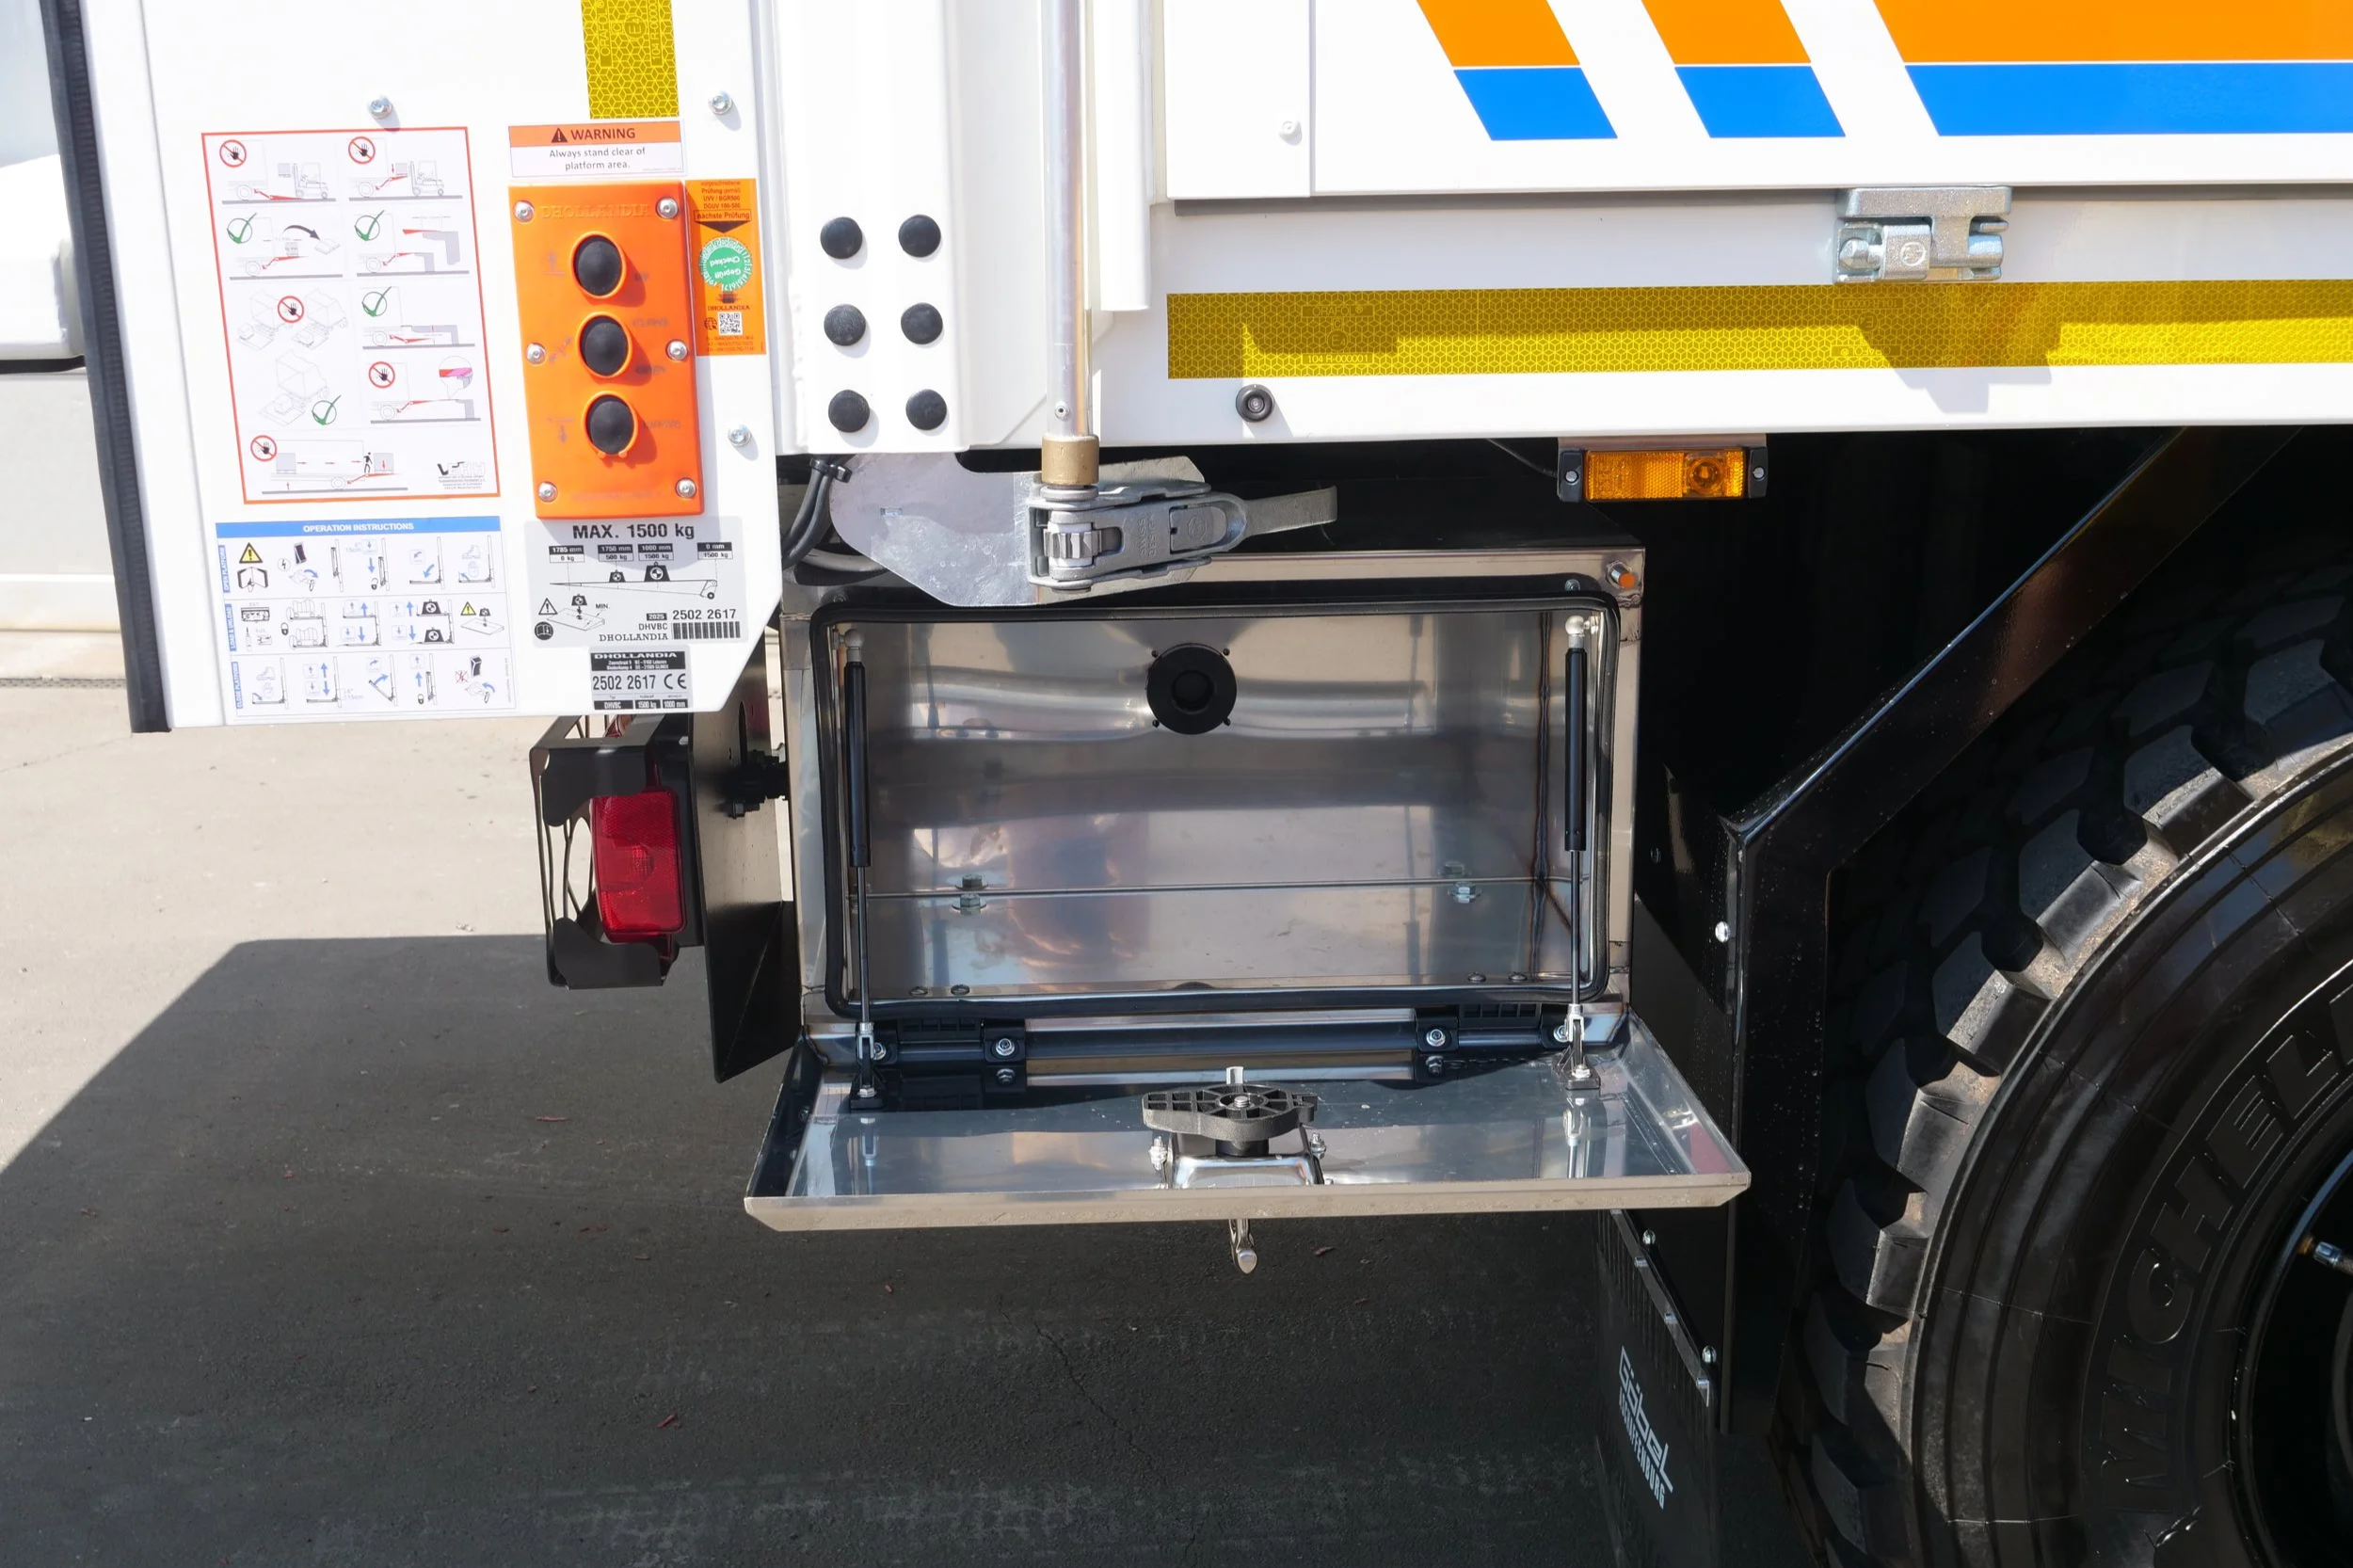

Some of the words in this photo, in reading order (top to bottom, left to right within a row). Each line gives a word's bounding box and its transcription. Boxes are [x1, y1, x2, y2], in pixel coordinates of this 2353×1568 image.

[570, 128, 635, 140] WARNING
[550, 149, 582, 159] Always
[584, 148, 609, 156] stand
[612, 148, 633, 156] clear
[636, 147, 646, 155] of
[565, 162, 604, 171] platform
[540, 203, 651, 219] DHOLLANDIA
[724, 212, 749, 220] Prüfung
[710, 256, 741, 267] Checked
[1307, 354, 1322, 363] 104
[1325, 354, 1369, 363] R-000001
[303, 524, 352, 533] OPERATION
[353, 522, 414, 532] INSTRUCTIONS
[572, 524, 619, 539] MAX.
[626, 523, 667, 537] 1500
[675, 522, 695, 539] kg
[672, 609, 702, 620] 2502
[707, 608, 737, 619] 2617
[599, 633, 668, 642] DHOLLANDIA
[592, 675, 622, 690] 2502
[627, 675, 656, 690] 2617
[1619, 1386, 1665, 1510] ASCHAFFENBURG
